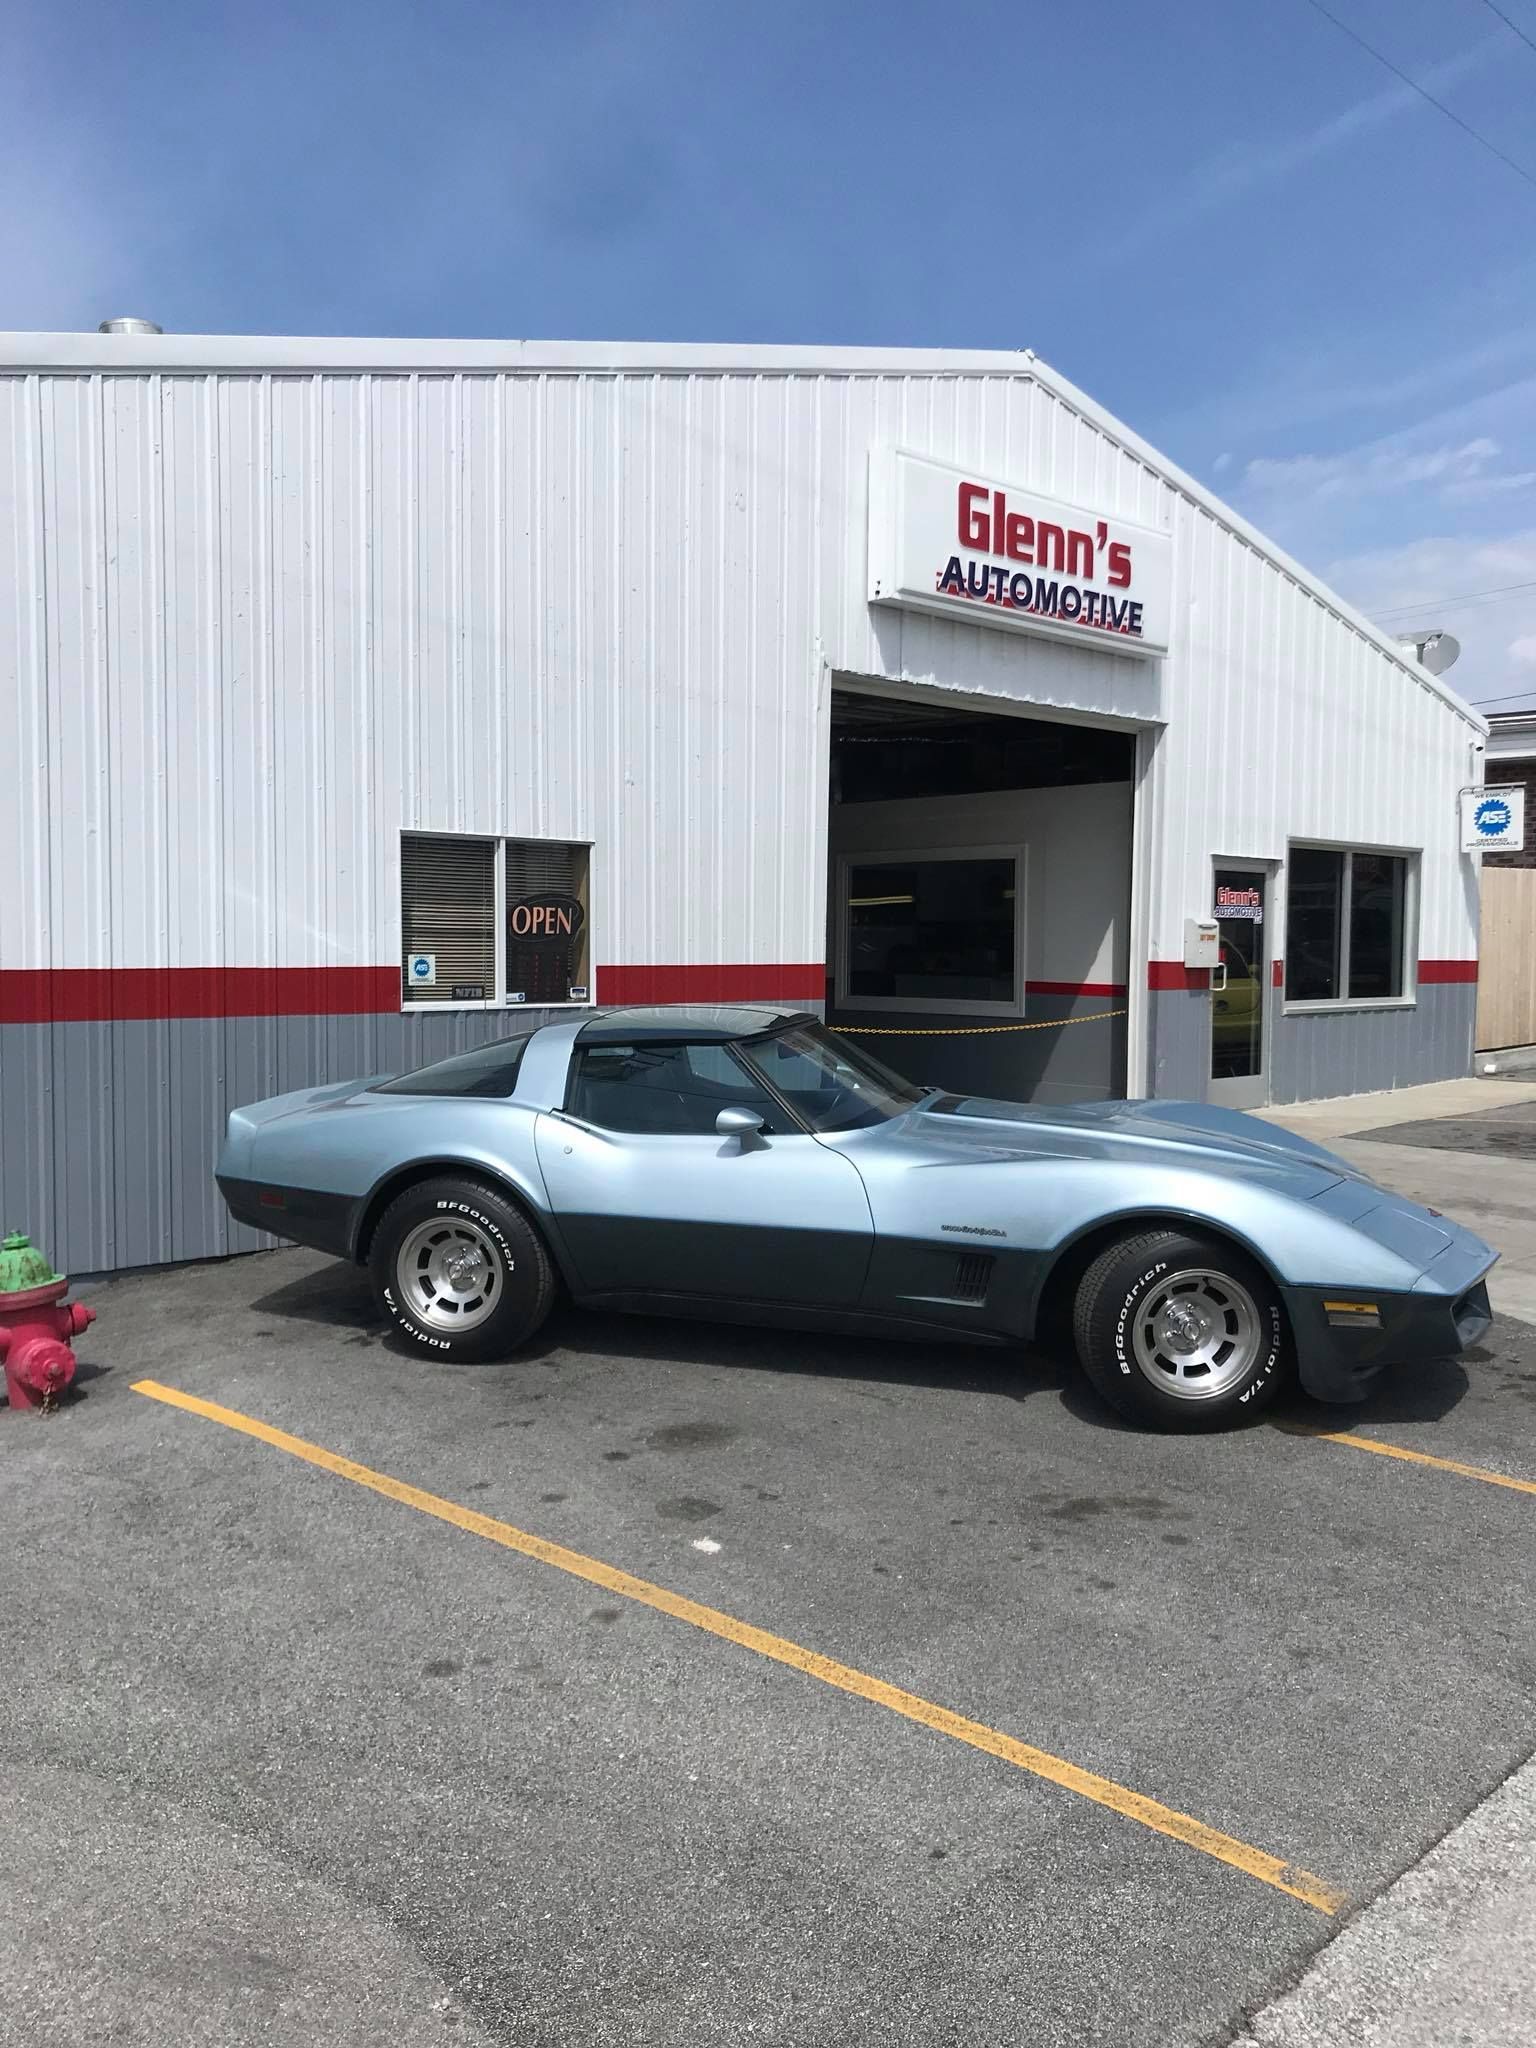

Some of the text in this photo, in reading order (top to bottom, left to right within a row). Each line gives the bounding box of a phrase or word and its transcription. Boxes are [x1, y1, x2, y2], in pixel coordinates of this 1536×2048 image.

[958, 481, 1131, 588] Glenn's
[937, 556, 1143, 636] AUTOMOTIVE
[1478, 810, 1507, 825] ASE
[511, 905, 573, 935] OPEN
[1213, 906, 1263, 919] AUTOMOTIVE
[1217, 886, 1260, 907] Glenn's
[436, 1201, 515, 1271] BFGoodrich
[383, 1287, 451, 1350] Radial T/A
[1115, 1261, 1167, 1375] BFGoodrich
[1239, 1305, 1281, 1403] Radial T/A
